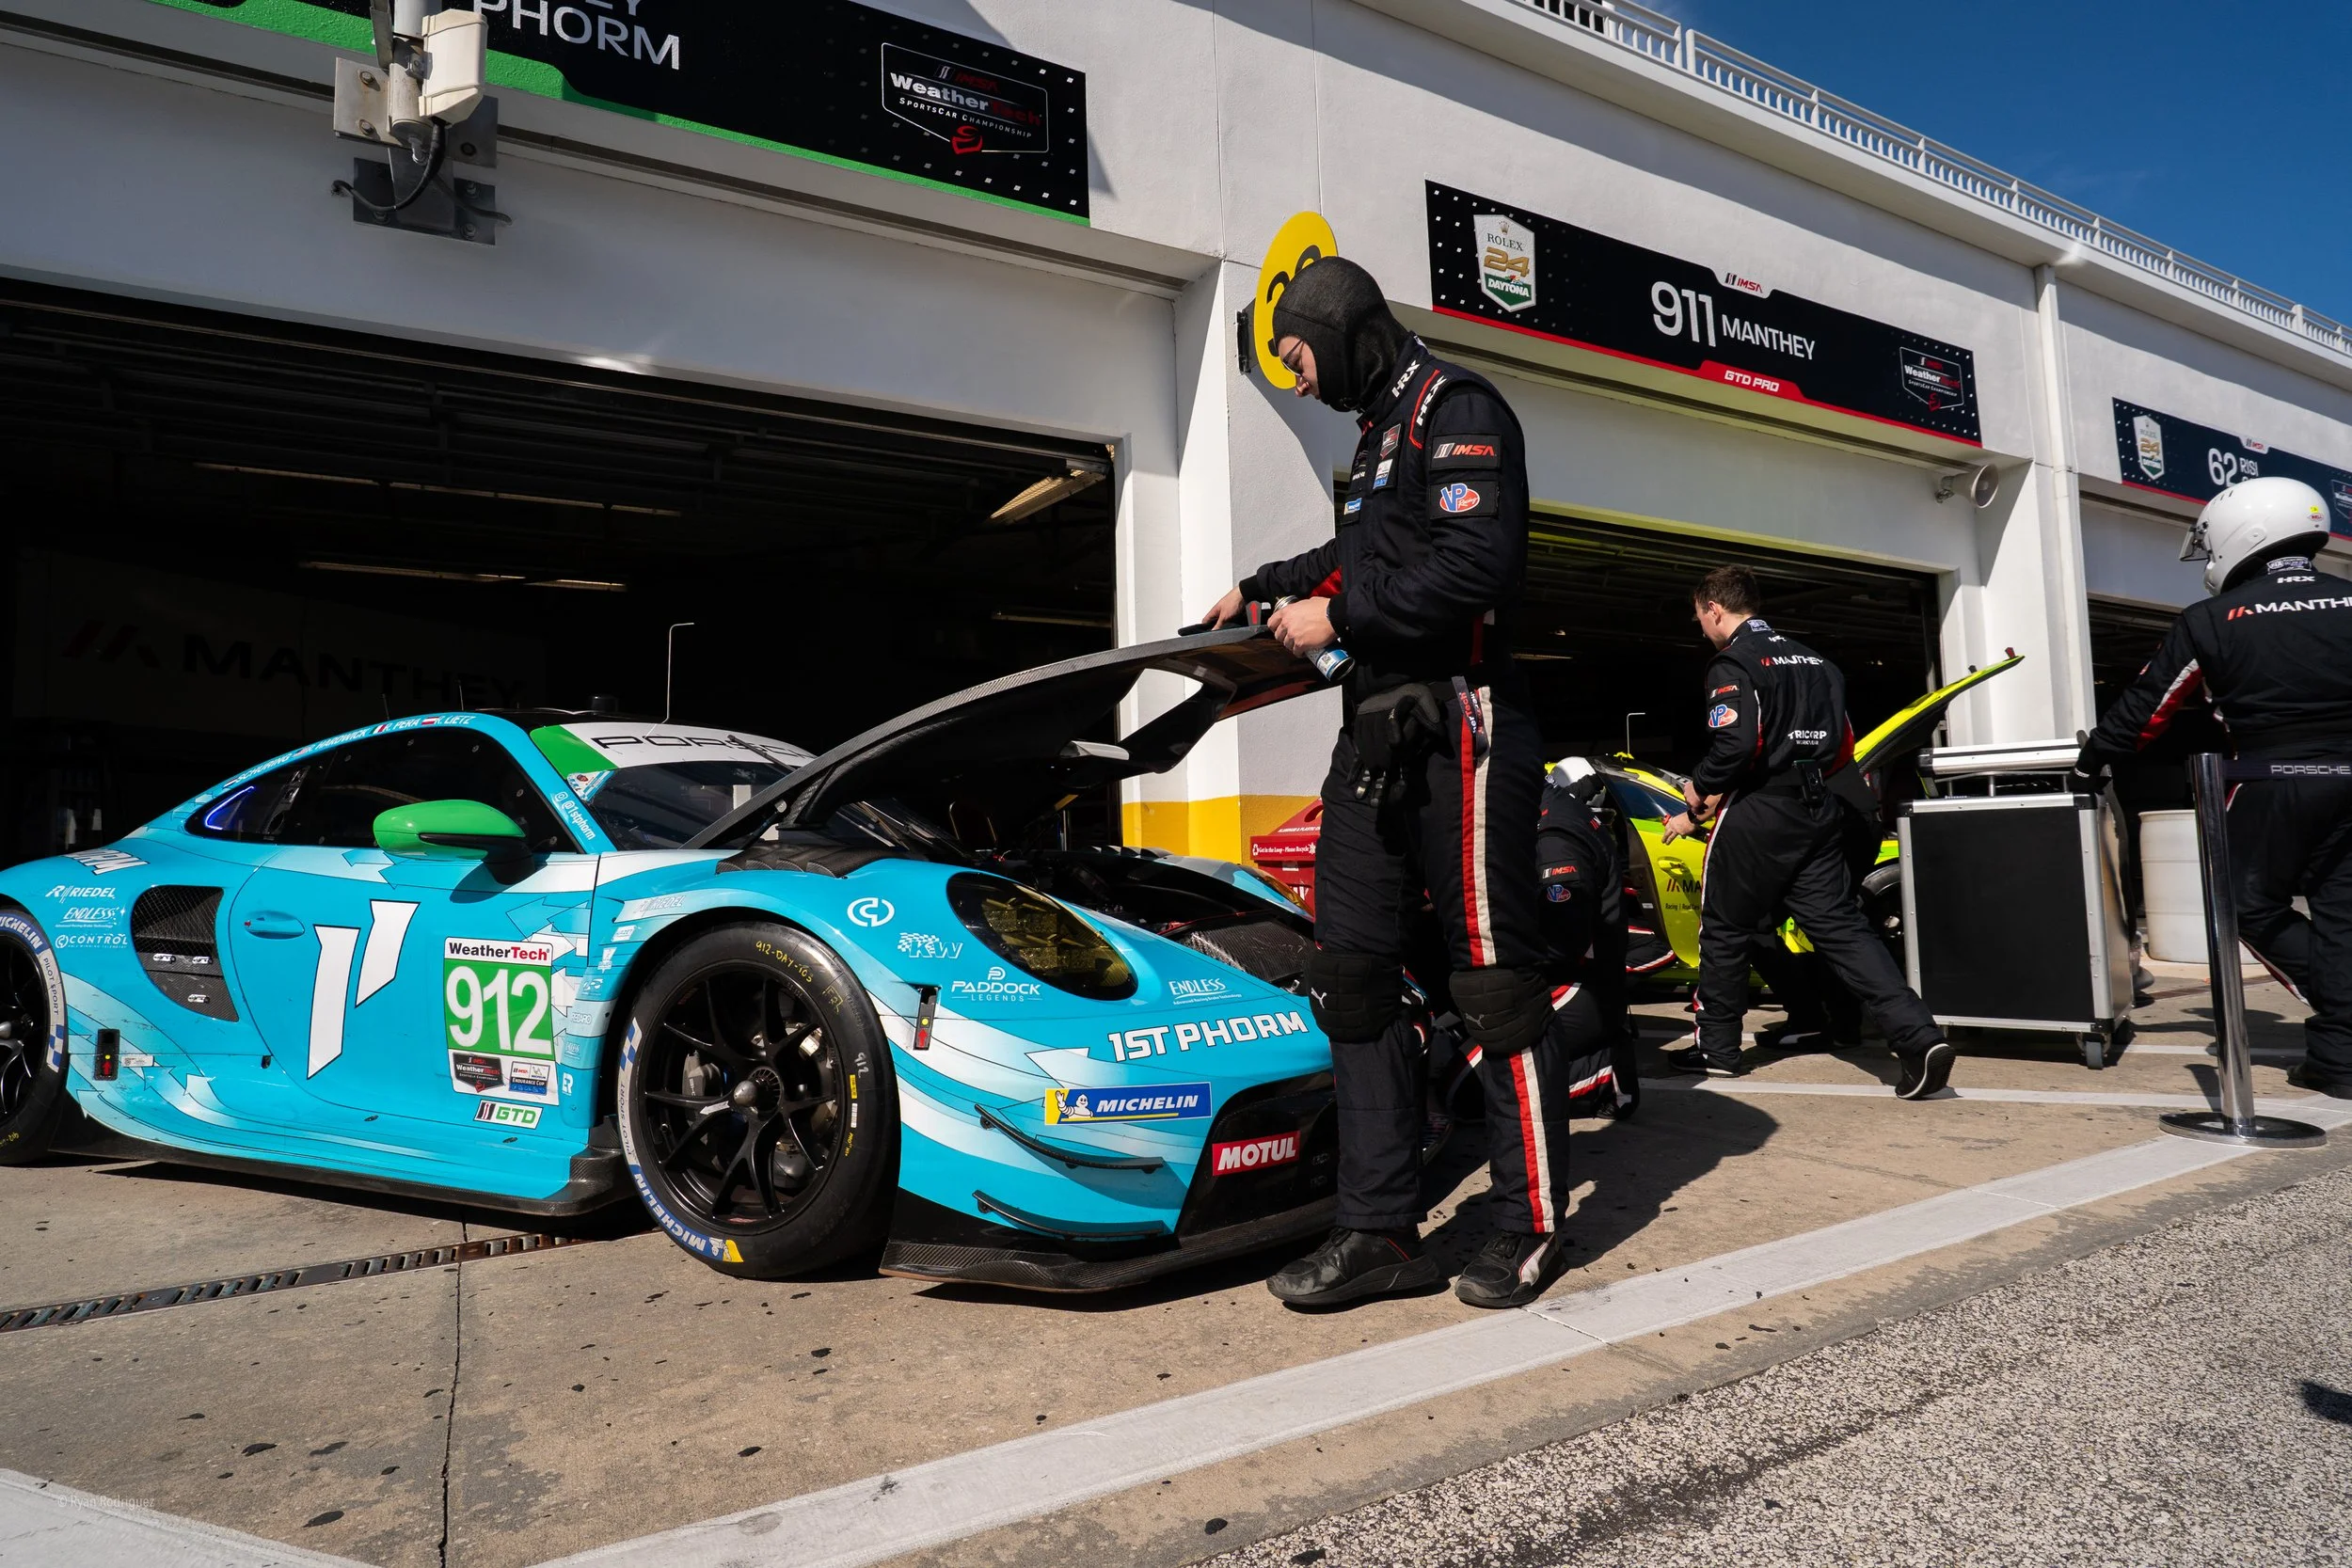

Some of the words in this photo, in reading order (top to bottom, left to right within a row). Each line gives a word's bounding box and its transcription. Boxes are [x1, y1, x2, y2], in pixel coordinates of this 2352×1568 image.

[890, 72, 1041, 125] WeatherTech
[1487, 233, 1524, 251] ROLEX
[1484, 246, 1531, 277] 24
[1487, 278, 1530, 297] DAYTONA
[1737, 277, 1763, 293] IMSA
[1651, 281, 1717, 347] 911
[1722, 313, 1816, 360] MANTHEY
[1391, 359, 1421, 398] HRX
[1724, 370, 1752, 386] GTD
[1753, 377, 1780, 392] PRO
[1416, 375, 1447, 426] HRX
[1452, 445, 1495, 456] IMSA
[2207, 448, 2238, 486] 62
[1440, 483, 1468, 512] VP
[183, 634, 529, 706] MANTHEY
[444, 715, 477, 725] LIETZ
[2270, 765, 2351, 775] PORSCHE
[1551, 865, 1577, 876] IMSA
[69, 887, 116, 899] RIEDEL
[63, 907, 115, 920] ENDLESS
[69, 936, 128, 945] CONTROL
[909, 941, 963, 958] KW
[449, 942, 548, 960] WeatherTech
[43, 958, 56, 981] PILOT
[51, 983, 59, 1016] SPORT
[951, 980, 1041, 995] PADDOCK
[1168, 977, 1227, 996] ENDLESS
[445, 965, 553, 1055] 912
[1108, 1025, 1169, 1062] 1ST
[1174, 1011, 1310, 1052] PHORM
[854, 1053, 869, 1079] 912
[1096, 1095, 1199, 1113] MICHELIN
[496, 1106, 537, 1124] GTD
[622, 1125, 633, 1156] PILOT
[1217, 1138, 1297, 1171] MOTUL
[634, 1173, 707, 1252] MICHELIN
